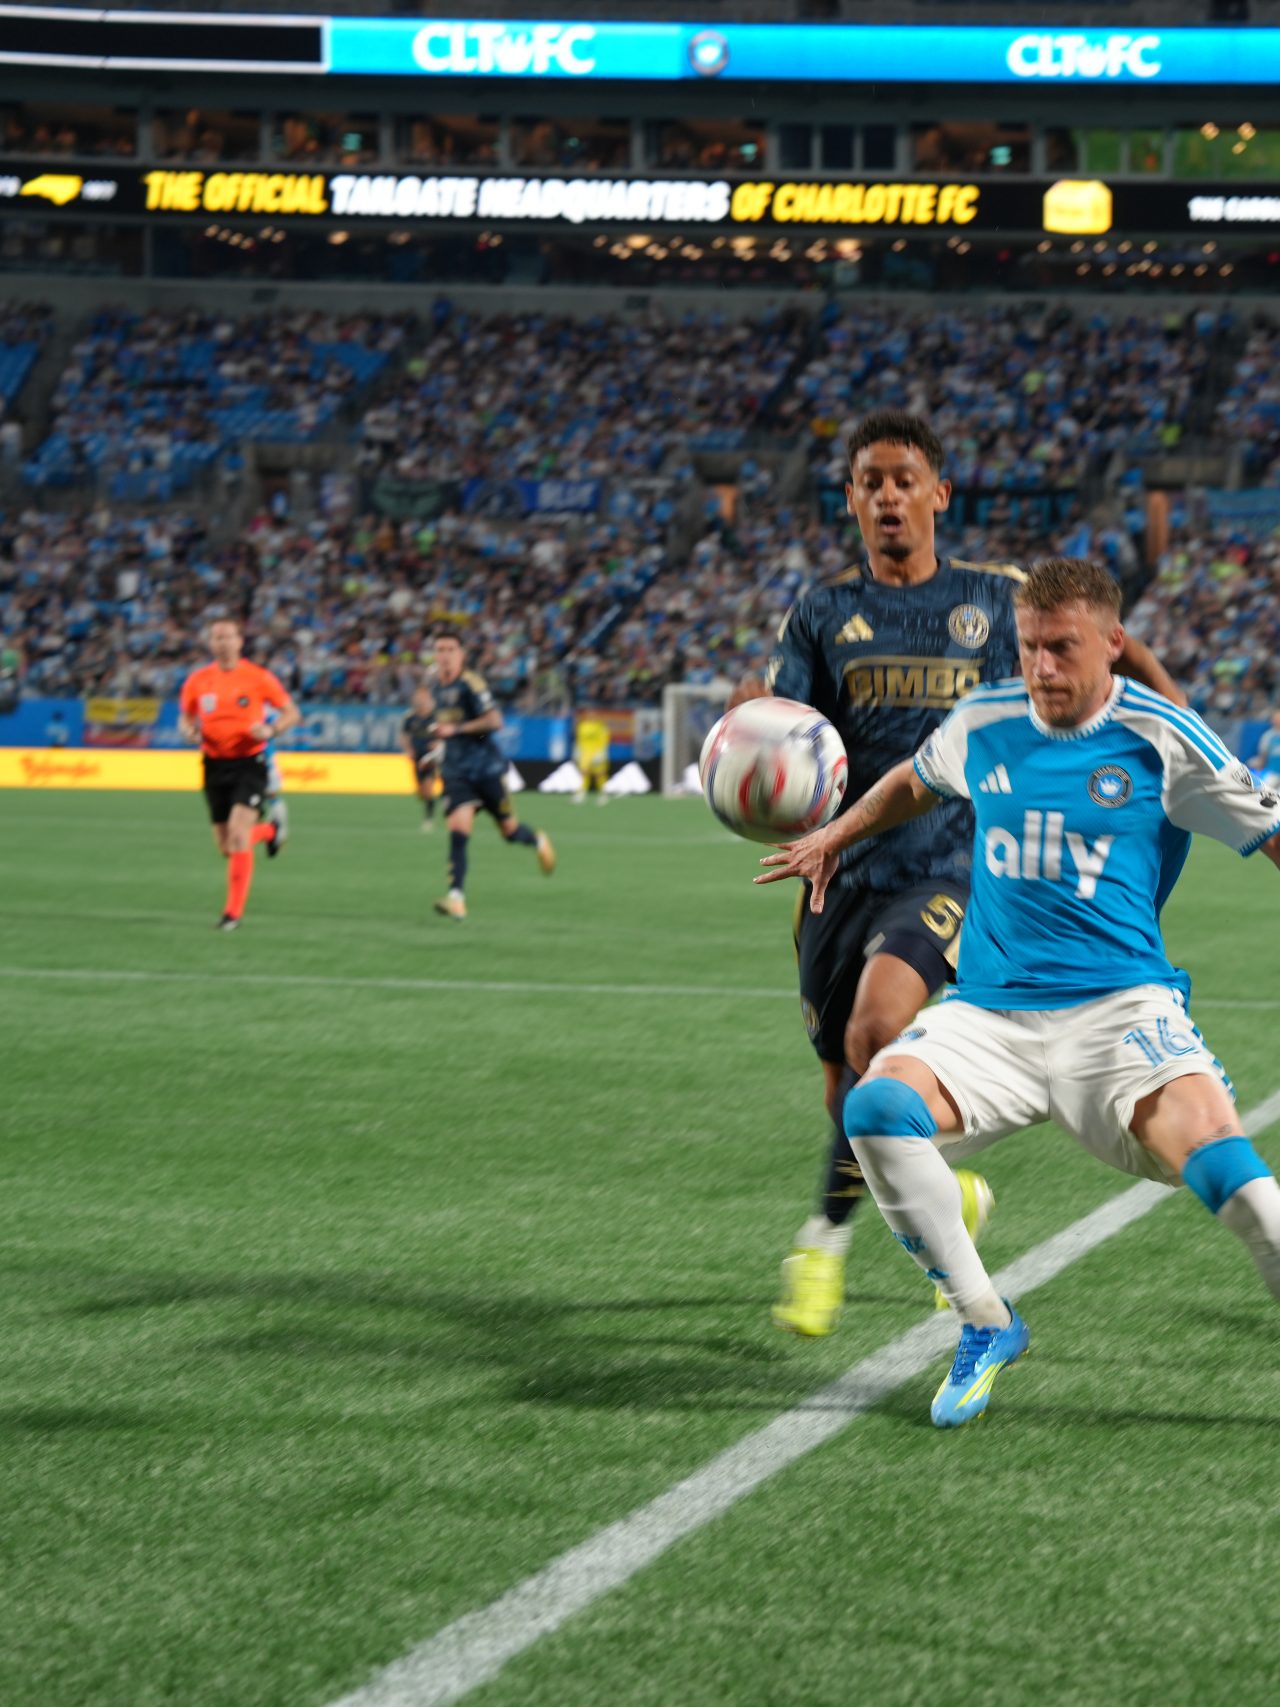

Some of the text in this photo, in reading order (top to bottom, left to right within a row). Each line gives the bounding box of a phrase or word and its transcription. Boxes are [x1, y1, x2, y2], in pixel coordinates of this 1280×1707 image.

[144, 171, 203, 210] THE
[203, 173, 327, 213] OFFICIAL
[330, 175, 477, 216] TAILGATE
[477, 177, 730, 223] HEADQUARTERS
[731, 182, 774, 222] OF
[772, 183, 938, 223] CHARLOTTE
[936, 185, 980, 223] FC
[848, 666, 981, 700] BIMBO
[985, 809, 1115, 899] ally
[920, 893, 964, 940] 5
[1122, 1015, 1199, 1068] 16
